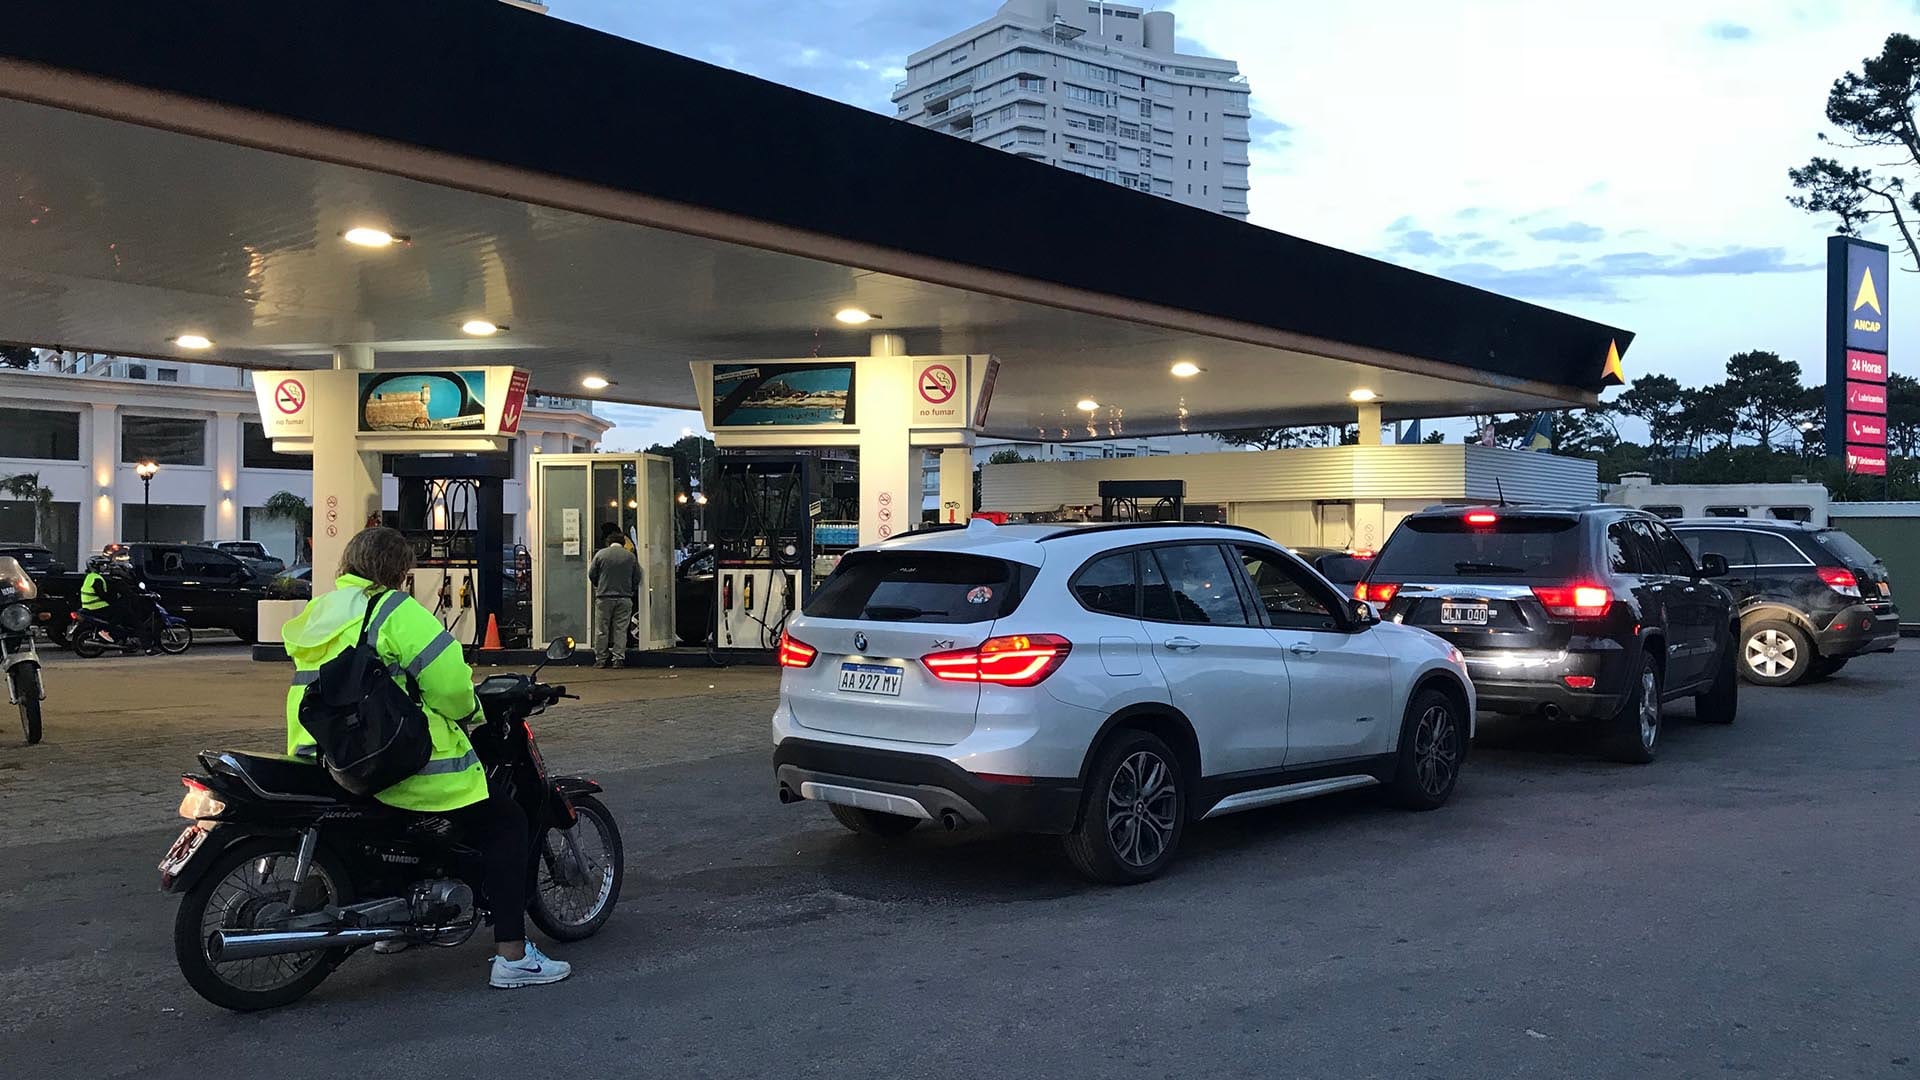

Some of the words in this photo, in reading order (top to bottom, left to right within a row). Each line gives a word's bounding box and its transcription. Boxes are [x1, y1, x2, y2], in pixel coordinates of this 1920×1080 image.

[1854, 319, 1881, 333] ANCAP
[1852, 358, 1861, 371] 24
[1861, 360, 1882, 375] Horas
[932, 408, 955, 416] fumar
[1443, 608, 1462, 620] MLN
[1467, 609, 1486, 621] 040
[931, 639, 955, 649] X1
[841, 672, 855, 688] AA
[859, 673, 880, 690] 927
[882, 676, 898, 692] MY
[381, 853, 419, 865] YUMBO
